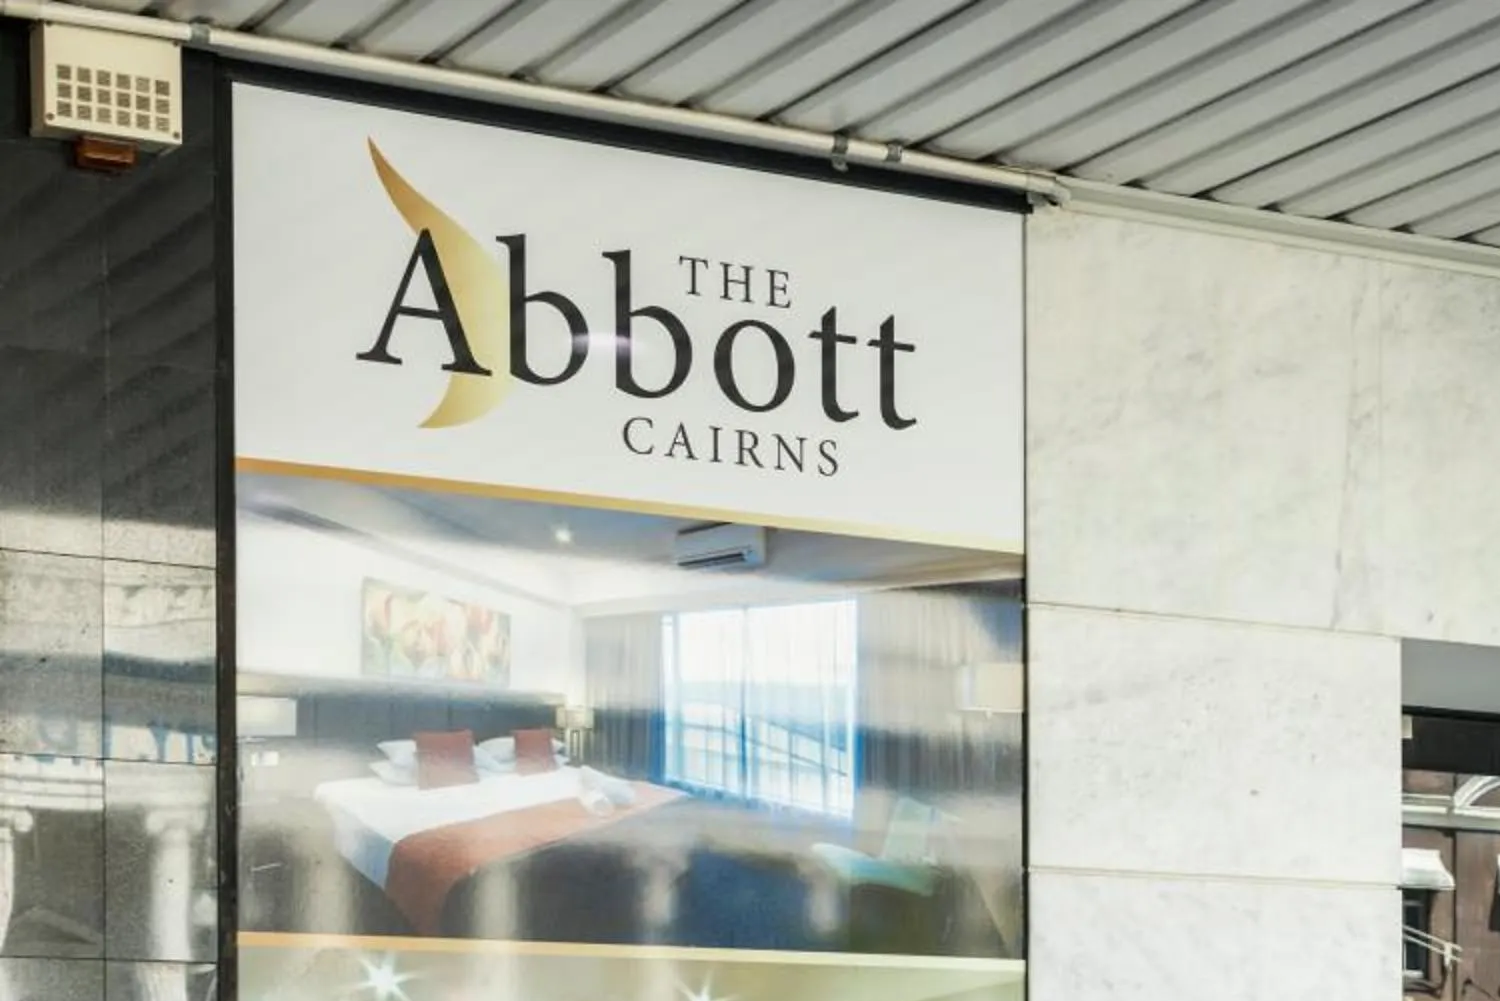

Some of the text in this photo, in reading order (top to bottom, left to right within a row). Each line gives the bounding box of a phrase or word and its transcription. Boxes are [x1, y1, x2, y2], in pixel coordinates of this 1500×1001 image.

[680, 256, 791, 309] THE
[357, 228, 917, 430] Abbott
[622, 417, 840, 476] CAIRNS
